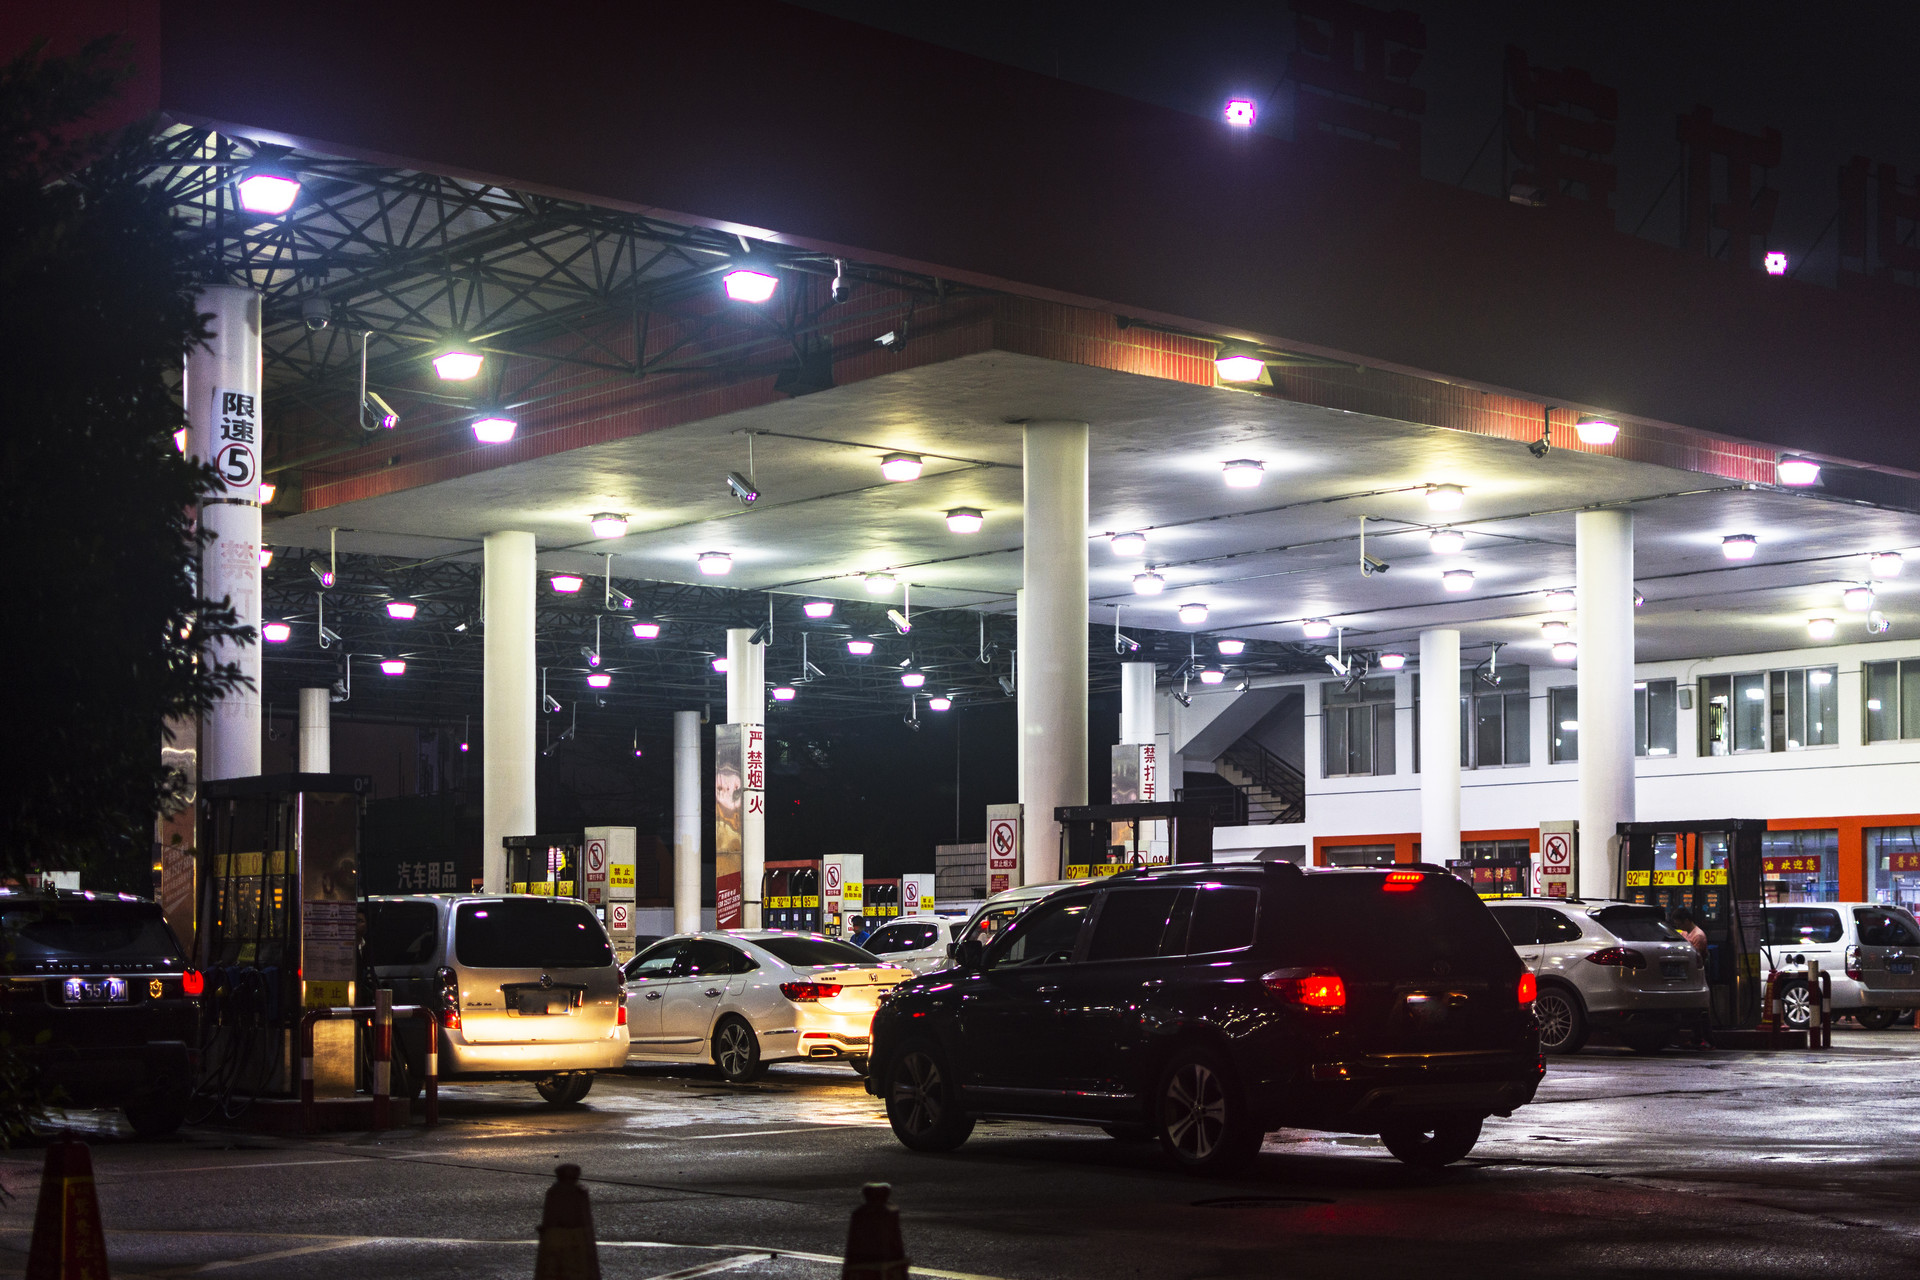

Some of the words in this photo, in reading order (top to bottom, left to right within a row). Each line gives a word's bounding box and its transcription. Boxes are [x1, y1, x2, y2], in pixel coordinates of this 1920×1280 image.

[220, 392, 255, 444] 限速
[226, 447, 249, 482] 5
[747, 730, 763, 815] 严禁烟火
[1143, 746, 1156, 800] 禁打手
[993, 860, 1014, 868] 禁止烟火
[397, 860, 457, 889] 汽车用品
[614, 867, 631, 876] 禁止
[1067, 866, 1078, 879] 92
[1092, 865, 1104, 878] 95
[1653, 871, 1664, 885] 92
[1677, 871, 1686, 884] 0
[1704, 870, 1716, 883] 95
[610, 877, 635, 885] 自助加油
[1627, 872, 1638, 885] 92
[776, 897, 784, 908] 92
[804, 896, 812, 907] 95
